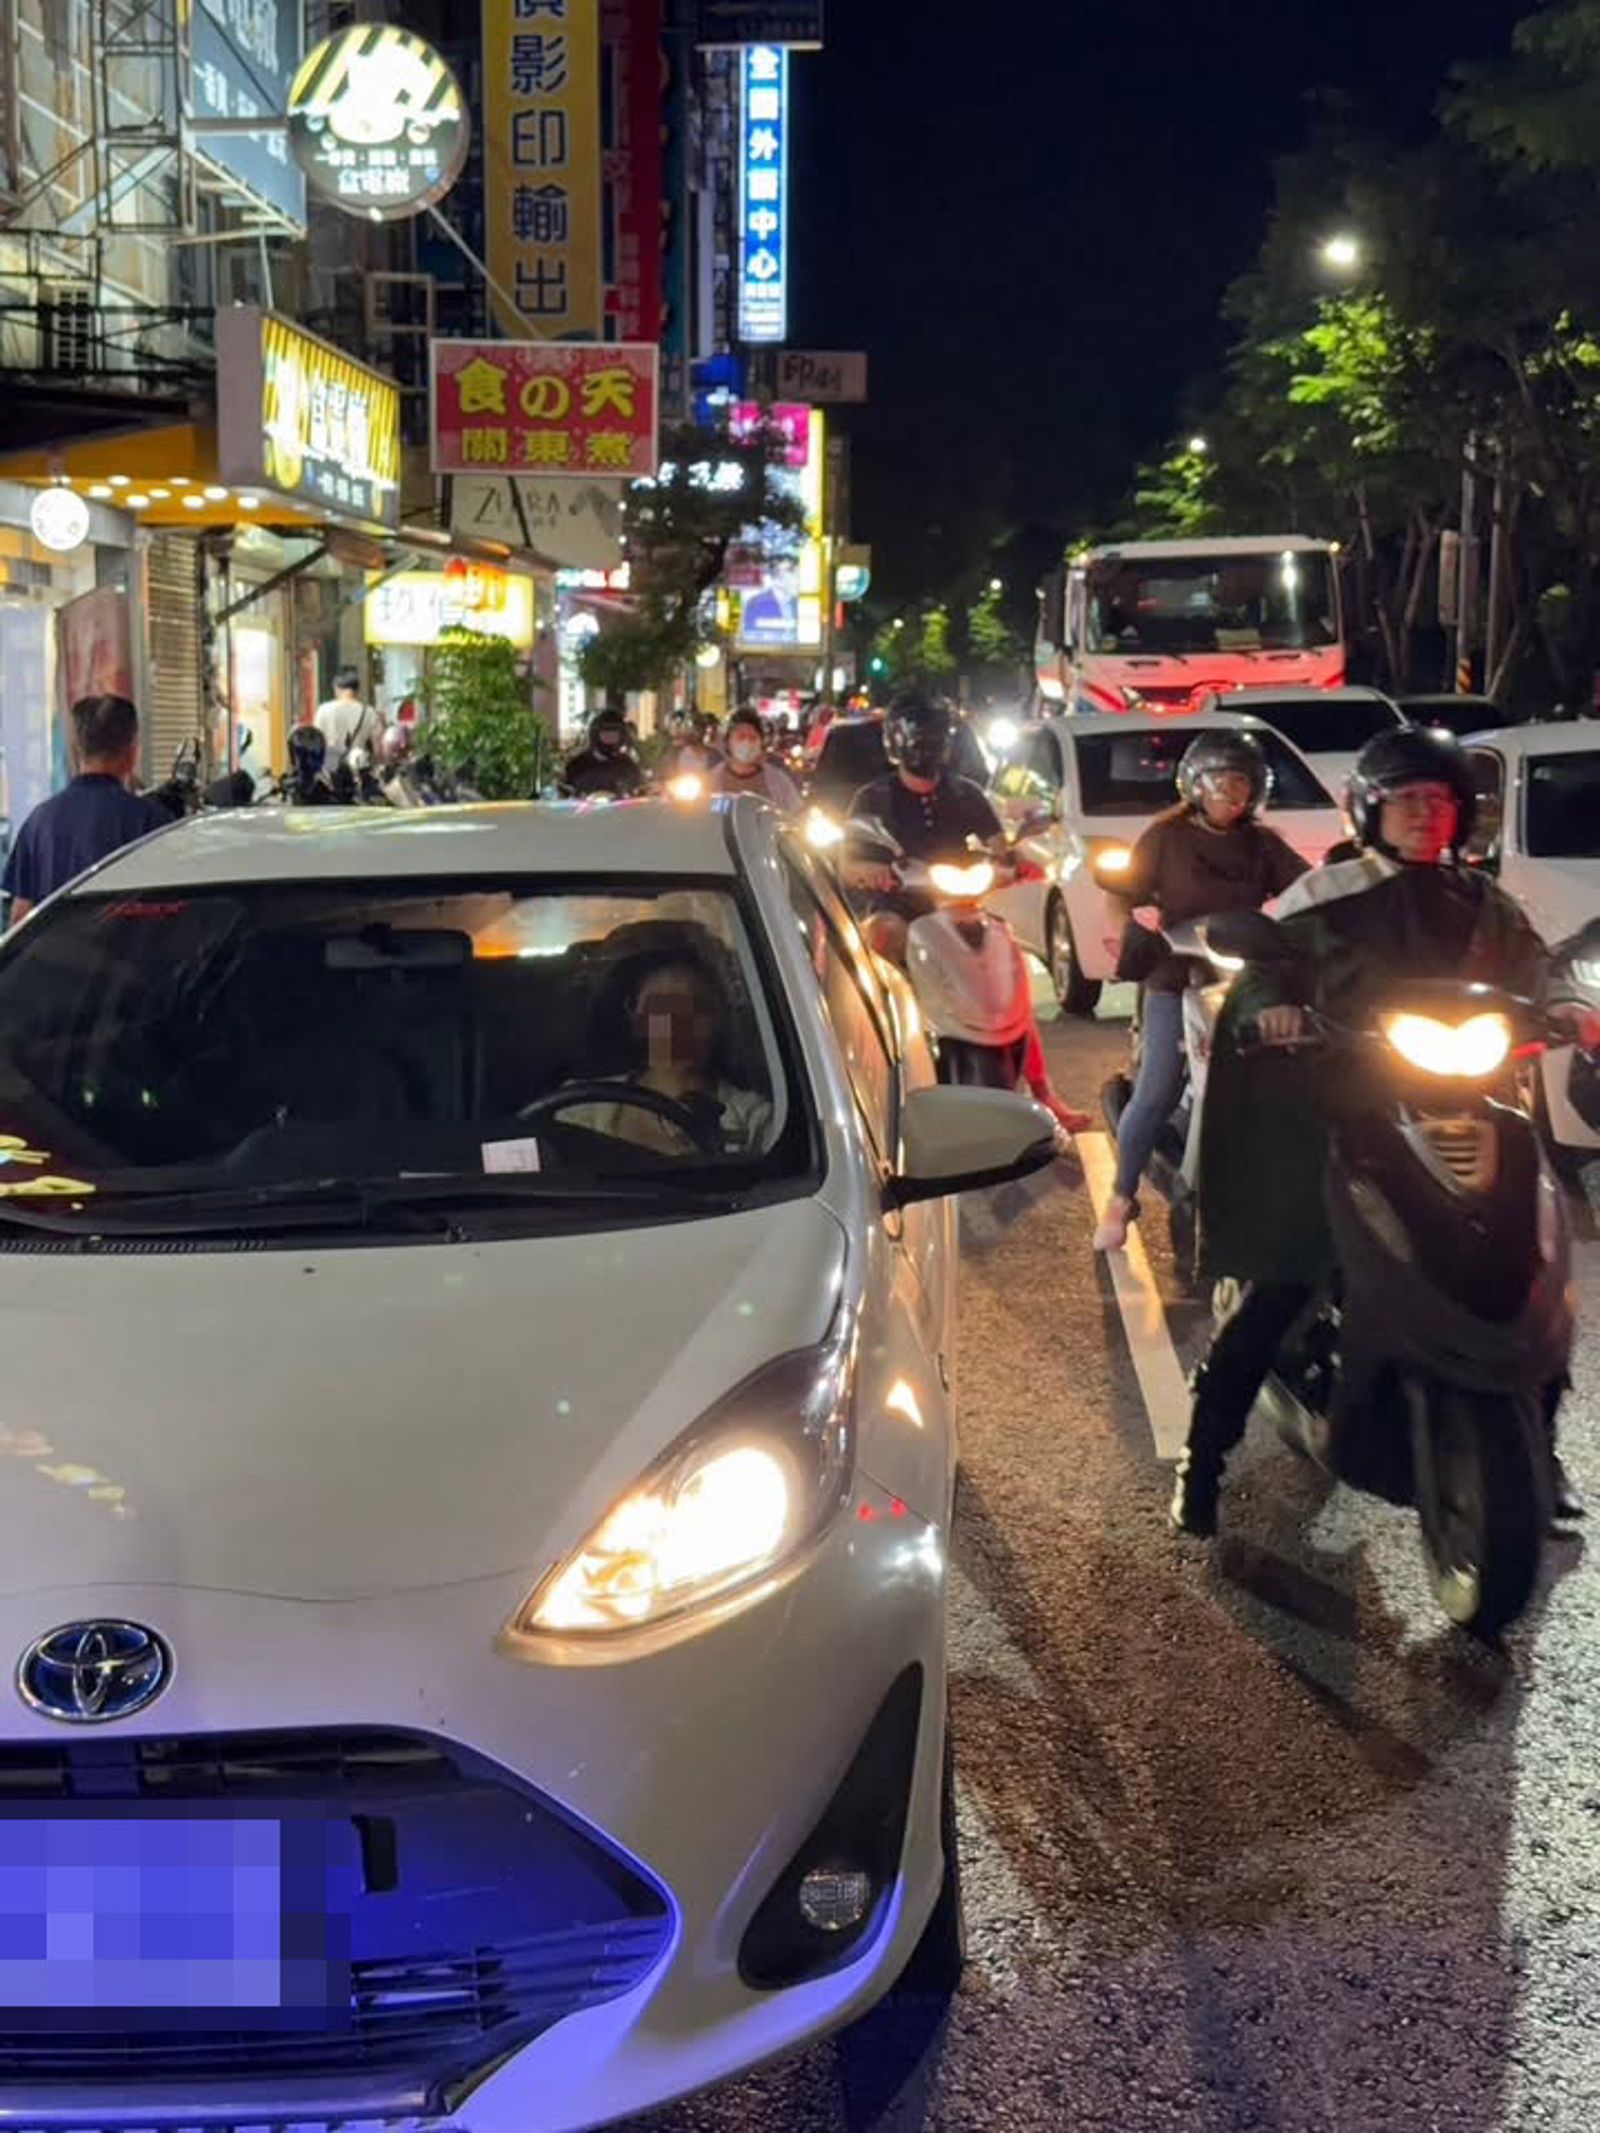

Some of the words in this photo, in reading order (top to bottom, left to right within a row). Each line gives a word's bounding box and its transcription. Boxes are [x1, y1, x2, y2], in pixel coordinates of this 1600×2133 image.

[454, 357, 635, 419] 食の天
[461, 429, 633, 466] 關東煮
[472, 485, 561, 524] ZRA
